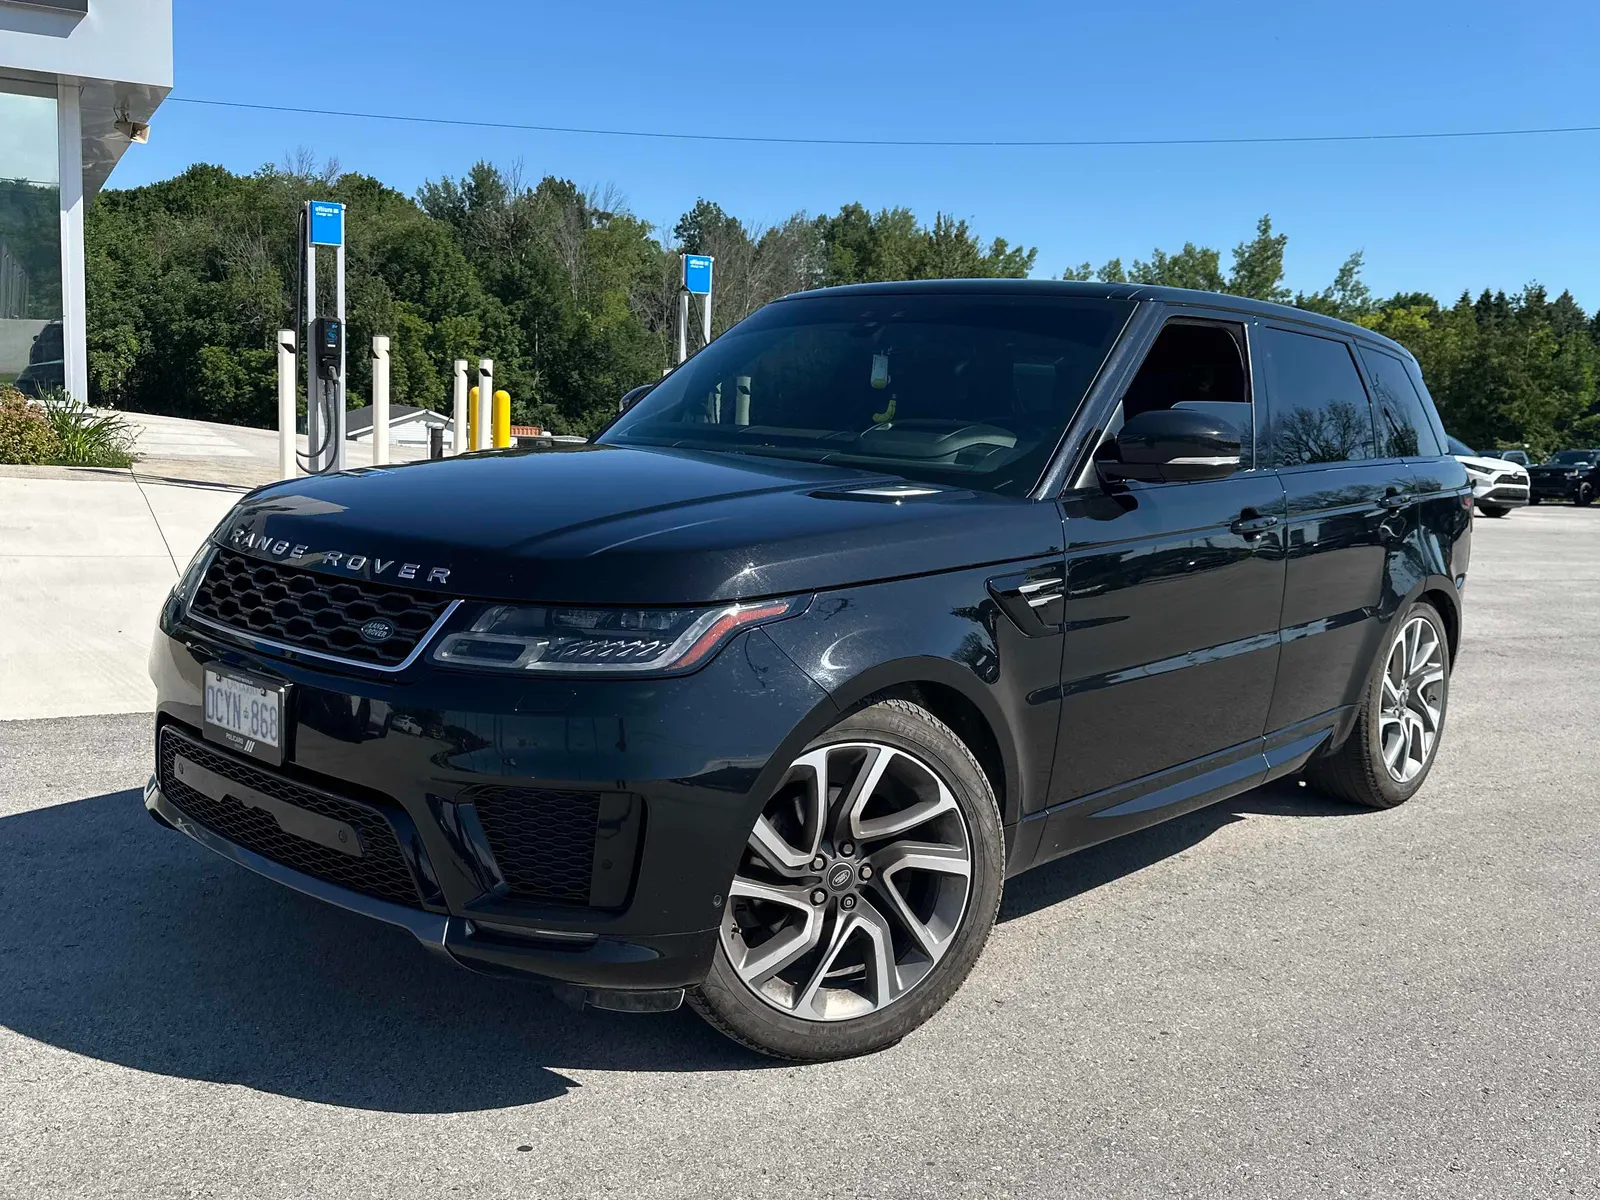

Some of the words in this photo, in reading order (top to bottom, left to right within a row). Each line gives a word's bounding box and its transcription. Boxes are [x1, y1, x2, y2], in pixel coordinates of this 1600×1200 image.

[229, 527, 309, 559] RANGE
[322, 550, 451, 584] ROVER
[366, 629, 387, 637] ROVER
[368, 622, 386, 630] LAND
[206, 687, 241, 730] DCYN
[251, 699, 278, 742] 868
